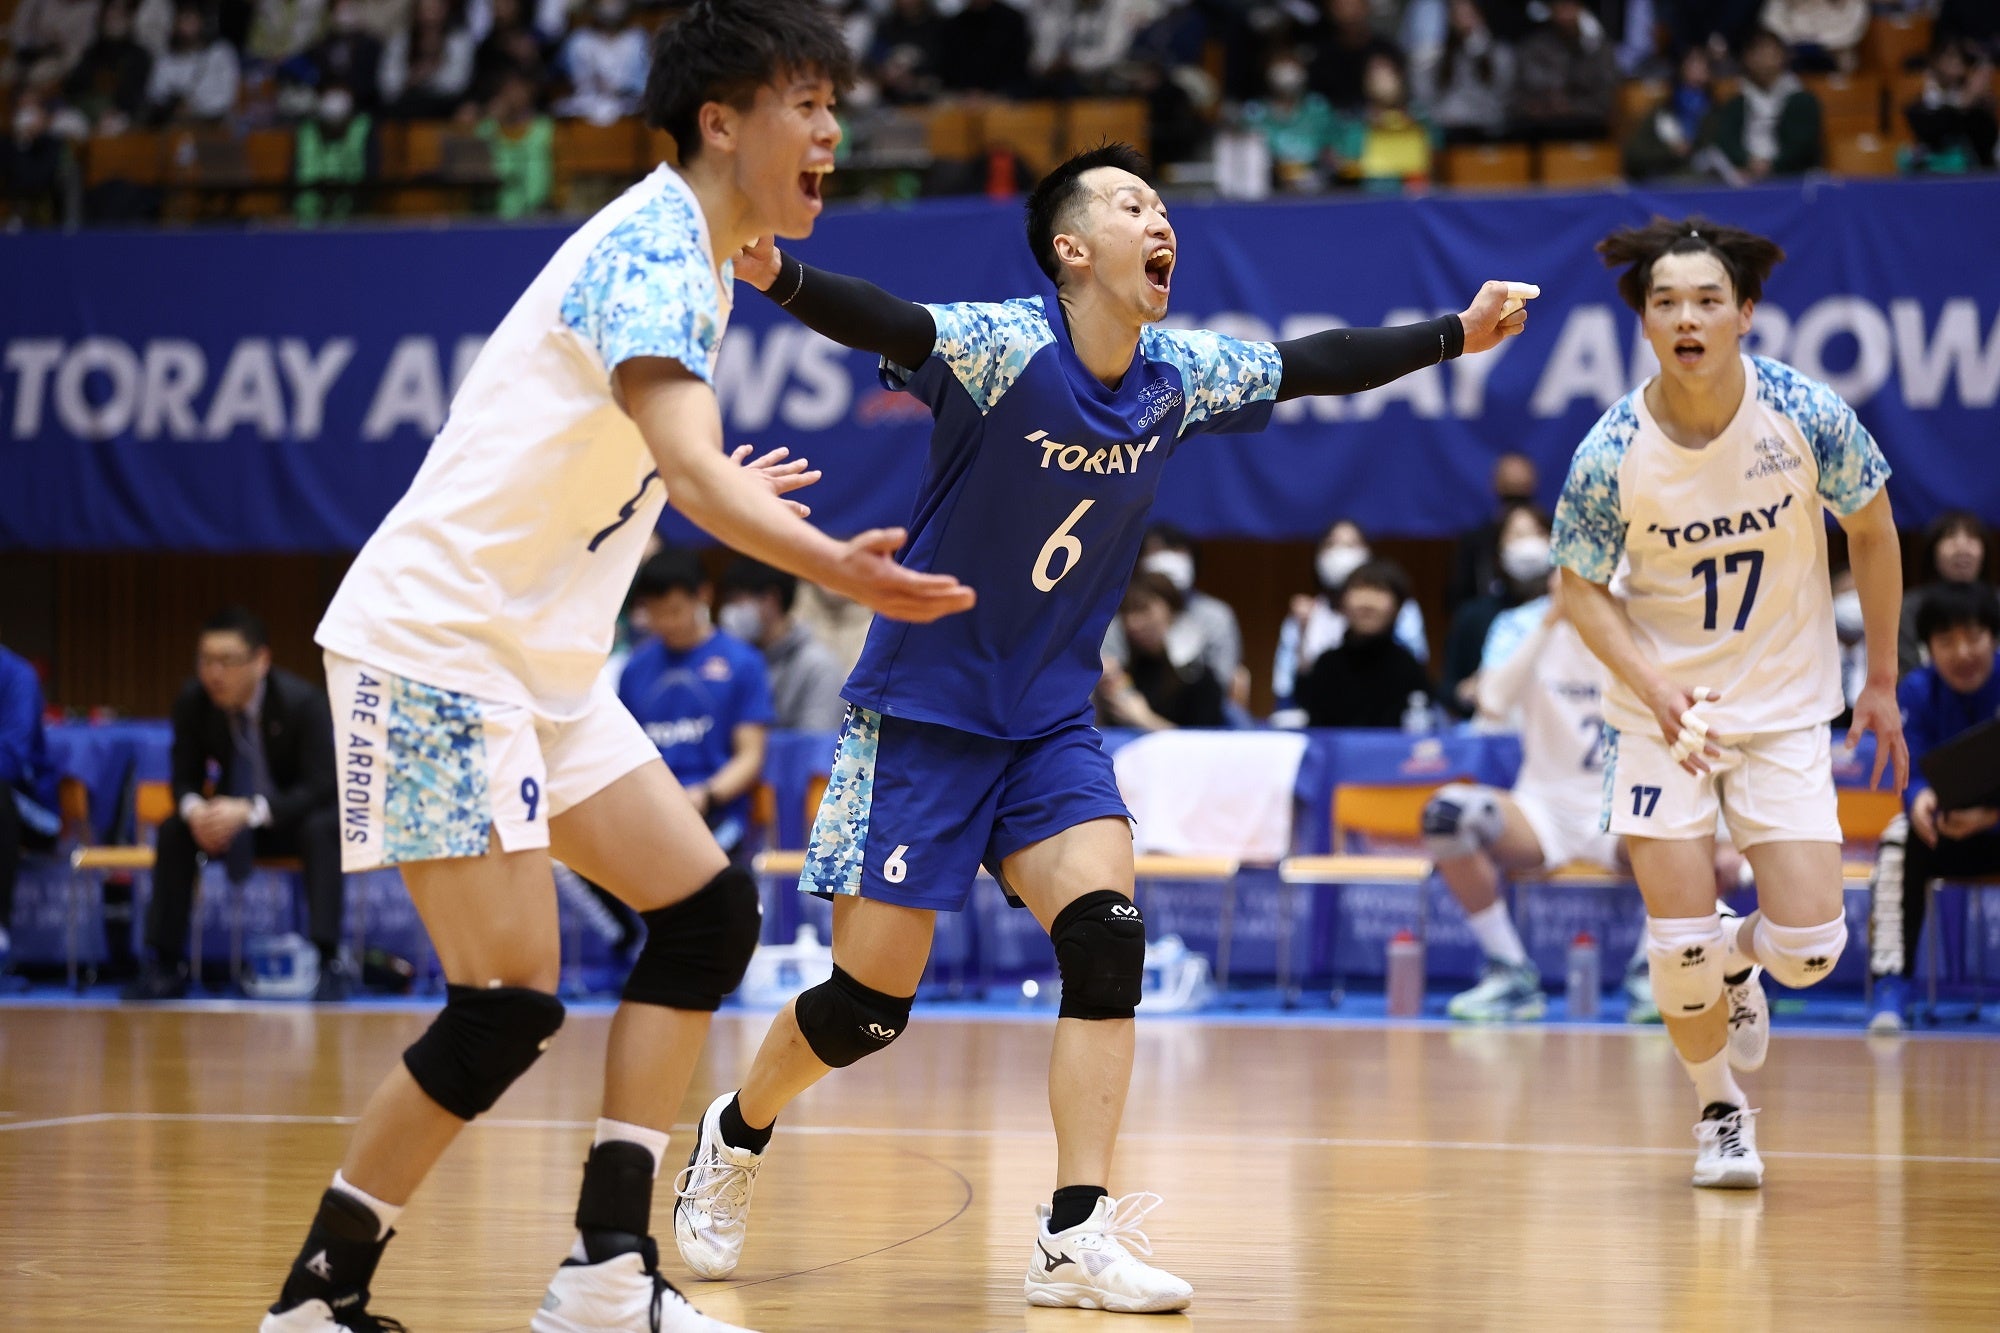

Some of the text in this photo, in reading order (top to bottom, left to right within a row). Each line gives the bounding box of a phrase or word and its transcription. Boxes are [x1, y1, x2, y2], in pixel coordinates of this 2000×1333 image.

[3, 334, 355, 443] TORAY
[1031, 499, 1096, 593] 6
[1691, 549, 1764, 632] 17
[351, 672, 381, 726] ARE
[344, 733, 375, 845] ARROWS
[520, 776, 540, 823] 9
[1630, 783, 1663, 818] 17
[883, 844, 910, 884] 6
